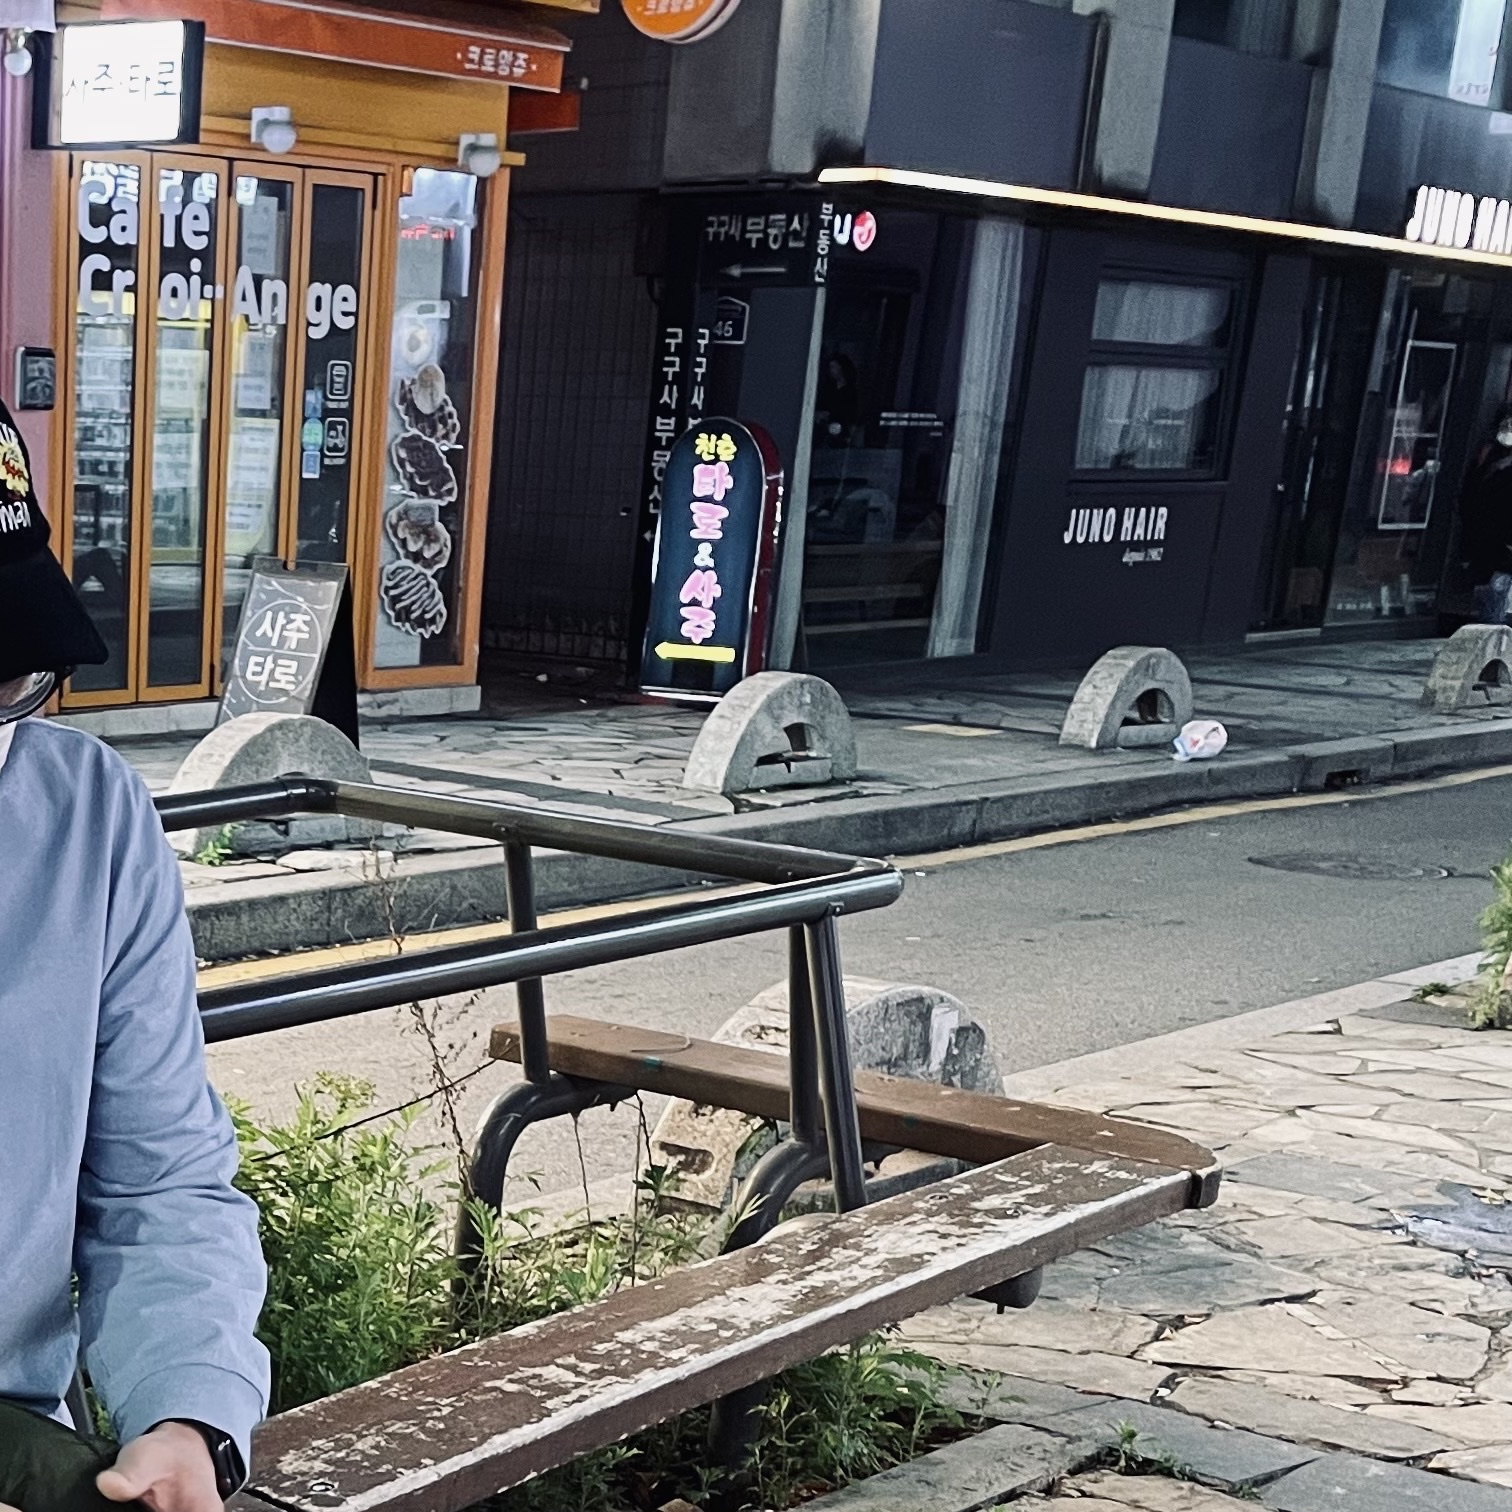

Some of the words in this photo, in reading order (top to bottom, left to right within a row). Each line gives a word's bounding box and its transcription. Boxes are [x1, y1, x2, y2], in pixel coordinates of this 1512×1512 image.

[1406, 185, 1474, 249] JUNO
[659, 327, 683, 410] 구구사
[691, 328, 709, 411] 구구사
[1063, 507, 1116, 544] JUNO
[1120, 506, 1168, 541] HAIR
[255, 610, 311, 650] 사주
[245, 654, 300, 691] 타로
